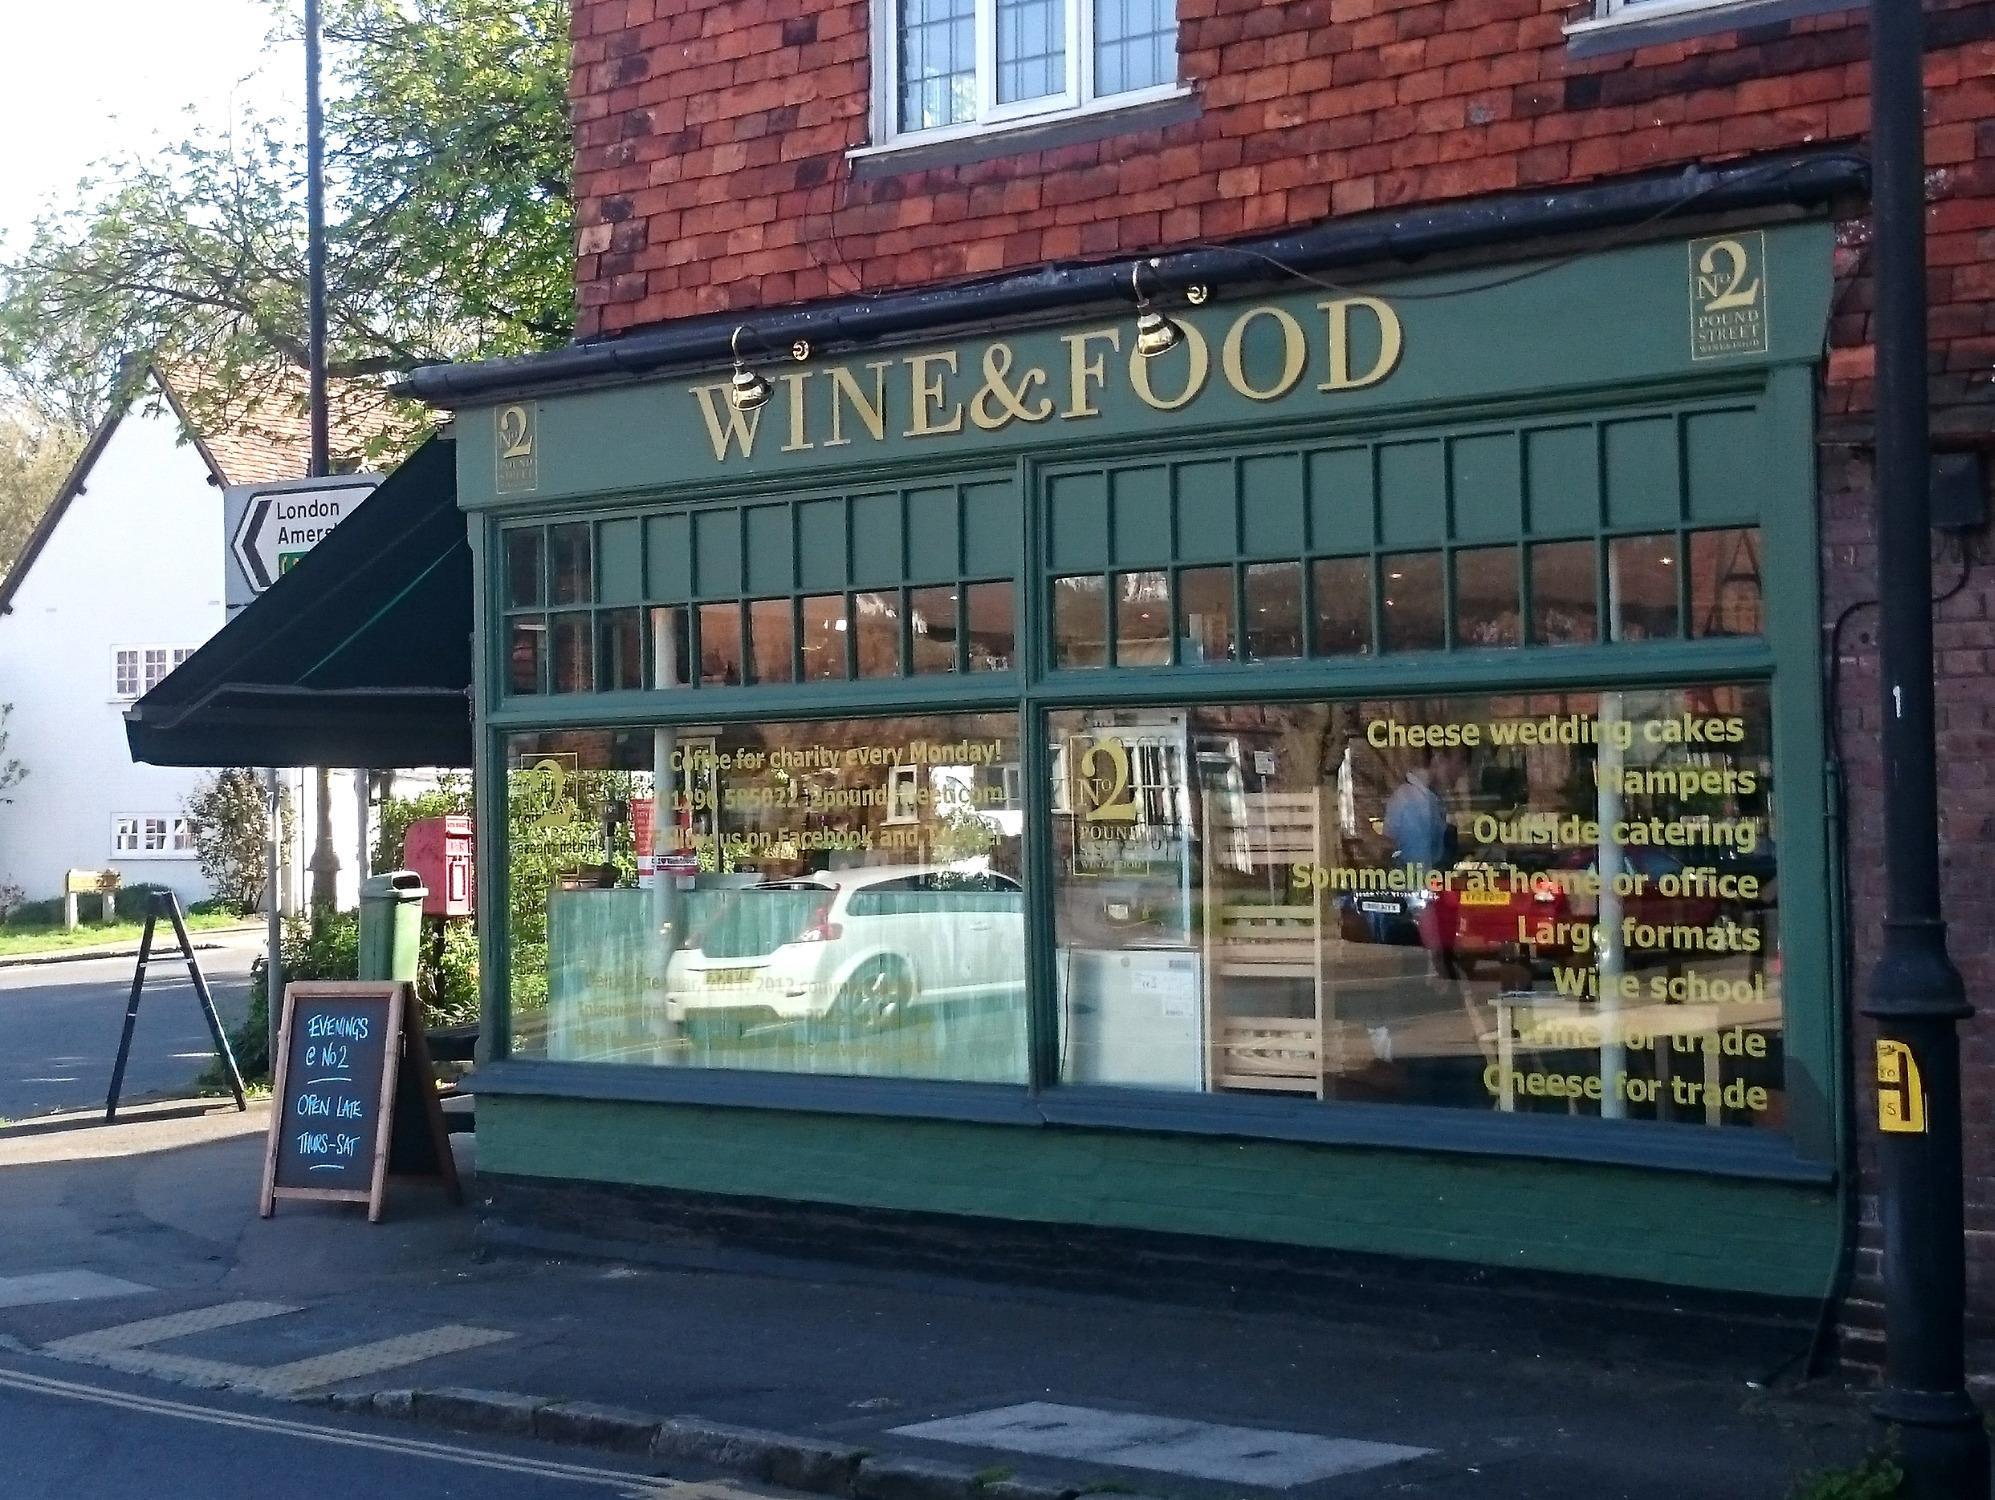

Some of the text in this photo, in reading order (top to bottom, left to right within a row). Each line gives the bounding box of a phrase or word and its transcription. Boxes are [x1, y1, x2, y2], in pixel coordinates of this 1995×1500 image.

[1699, 240, 1759, 311] 2
[501, 406, 533, 459] 2
[277, 499, 340, 520] London
[1367, 713, 1744, 749] Cheese wedding cakes
[670, 739, 1001, 772] Coffee for charity every Monday!
[1081, 737, 1137, 822] 2
[719, 831, 741, 848] us
[748, 831, 771, 850] on
[777, 824, 873, 849] Facebook
[879, 829, 916, 848] and
[1473, 813, 1757, 854] Outside catering
[1292, 862, 1759, 900] Sommelier at home or office
[1622, 916, 1761, 951] formats
[1650, 970, 1764, 1005] school
[307, 1014, 369, 1041] EVENINGS
[1670, 1025, 1767, 1058] trade
[1483, 1064, 1768, 1111] Cheese for trade
[297, 1095, 363, 1118] OPEN LATE
